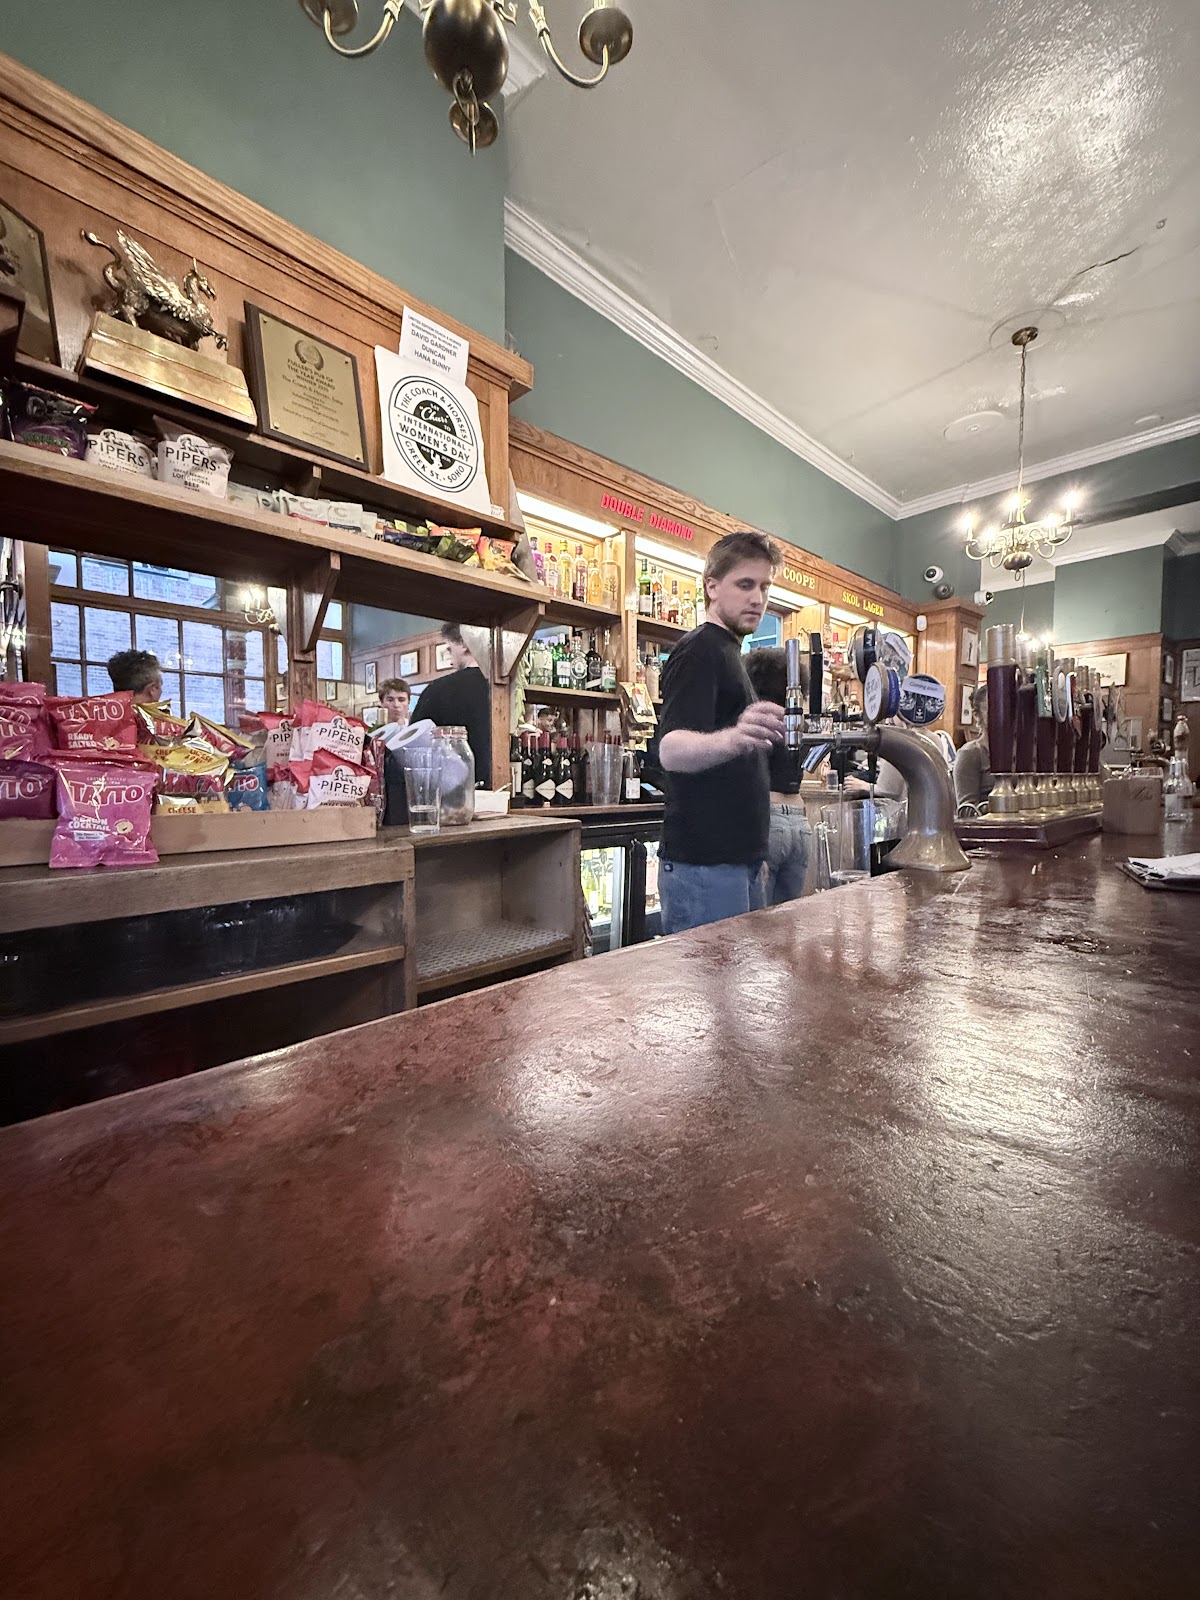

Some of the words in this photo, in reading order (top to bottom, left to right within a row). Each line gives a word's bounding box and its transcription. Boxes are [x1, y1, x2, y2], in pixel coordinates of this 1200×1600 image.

[411, 329, 429, 343] DAVID
[430, 339, 457, 358] GARDNER
[421, 344, 446, 361] DUNCAN
[287, 358, 313, 375] FULLER'S
[313, 371, 325, 380] PUB
[414, 349, 431, 363] HANA
[432, 359, 451, 372] SUNNY
[287, 365, 299, 374] THE
[299, 370, 314, 380] YEAR
[315, 377, 336, 391] AWARD
[296, 375, 317, 387] WINNER
[401, 393, 413, 409] THE
[410, 387, 438, 398] COACH
[440, 396, 446, 404] &
[447, 403, 468, 440] HORSES
[399, 422, 448, 452] WOMEN'S
[451, 447, 470, 462] DAY
[403, 414, 466, 451] INTERNATIONAL
[89, 439, 144, 467] PIPERS
[166, 447, 217, 471] PIPERS
[405, 440, 427, 472] GREEK
[447, 465, 465, 483] SOHO
[184, 480, 199, 488] BEEF
[601, 493, 644, 523] DOUBLE
[649, 512, 694, 541] DIAMOND
[783, 567, 816, 590] COOPE
[842, 591, 860, 608] SKOL
[863, 599, 884, 617] LAGER
[57, 700, 125, 721] TAYTO
[68, 733, 93, 741] READY
[68, 740, 97, 749] SALTED
[319, 727, 361, 746] PIPERS
[68, 780, 145, 806] TAYTO
[320, 780, 364, 796] PIPERS
[68, 821, 111, 832] COCKTAIL
